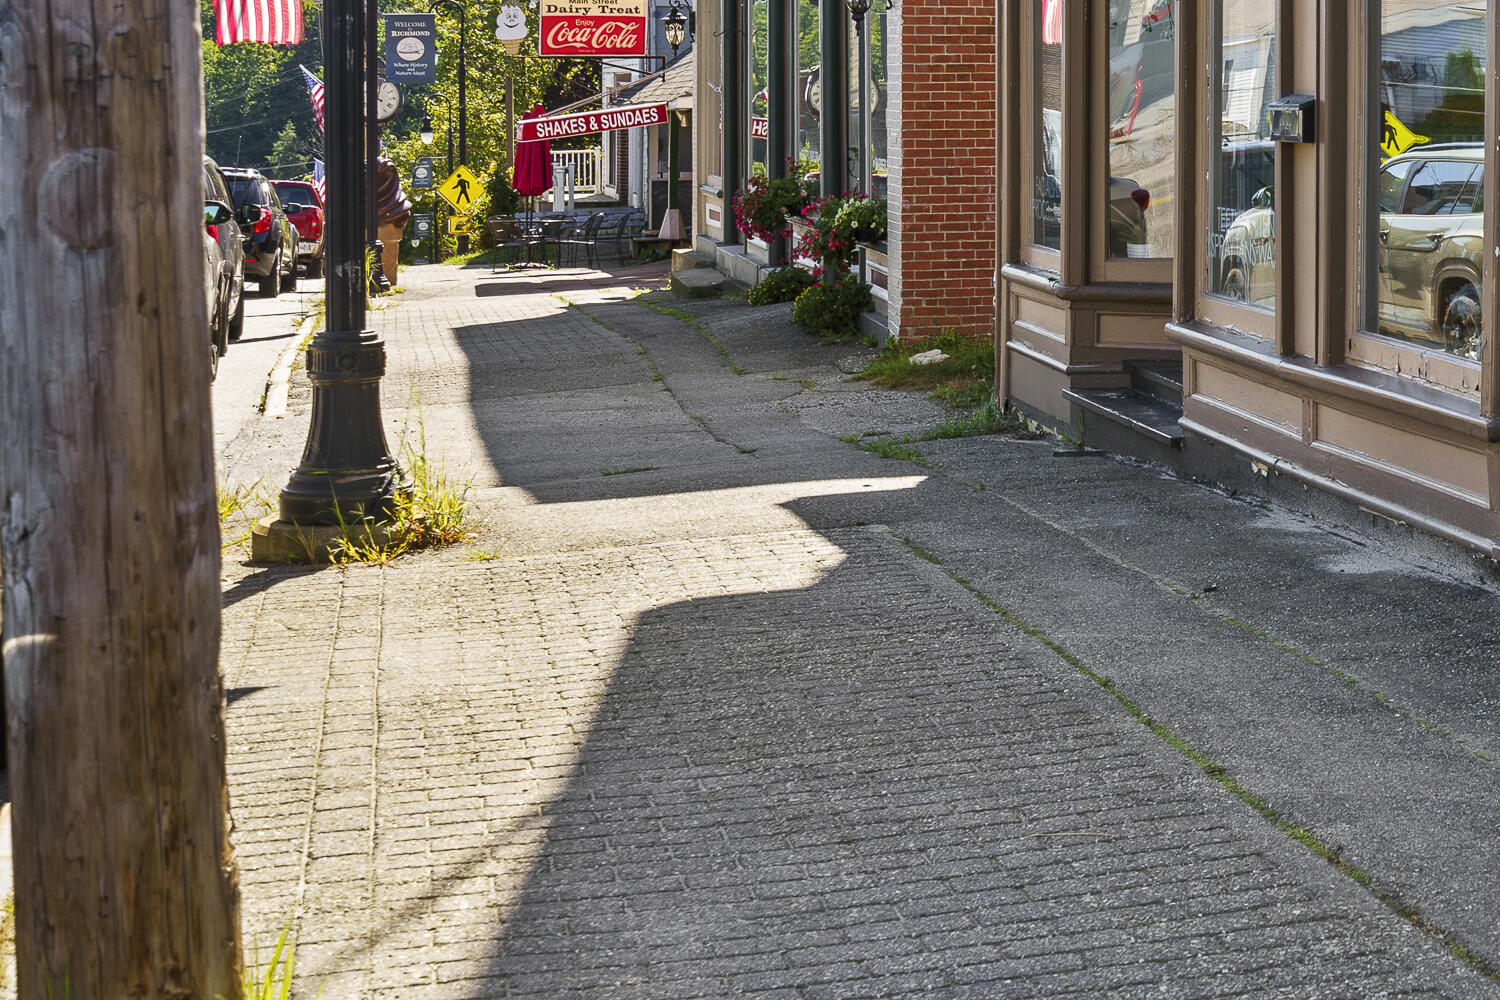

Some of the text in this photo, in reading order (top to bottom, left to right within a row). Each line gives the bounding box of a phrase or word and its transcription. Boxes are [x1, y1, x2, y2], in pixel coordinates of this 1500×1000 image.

[545, 4, 641, 16] Dairy Treat
[575, 19, 595, 28] Enjoy
[546, 20, 641, 49] Coca-Cola
[536, 107, 659, 138] SHAKES & SUNDAES
